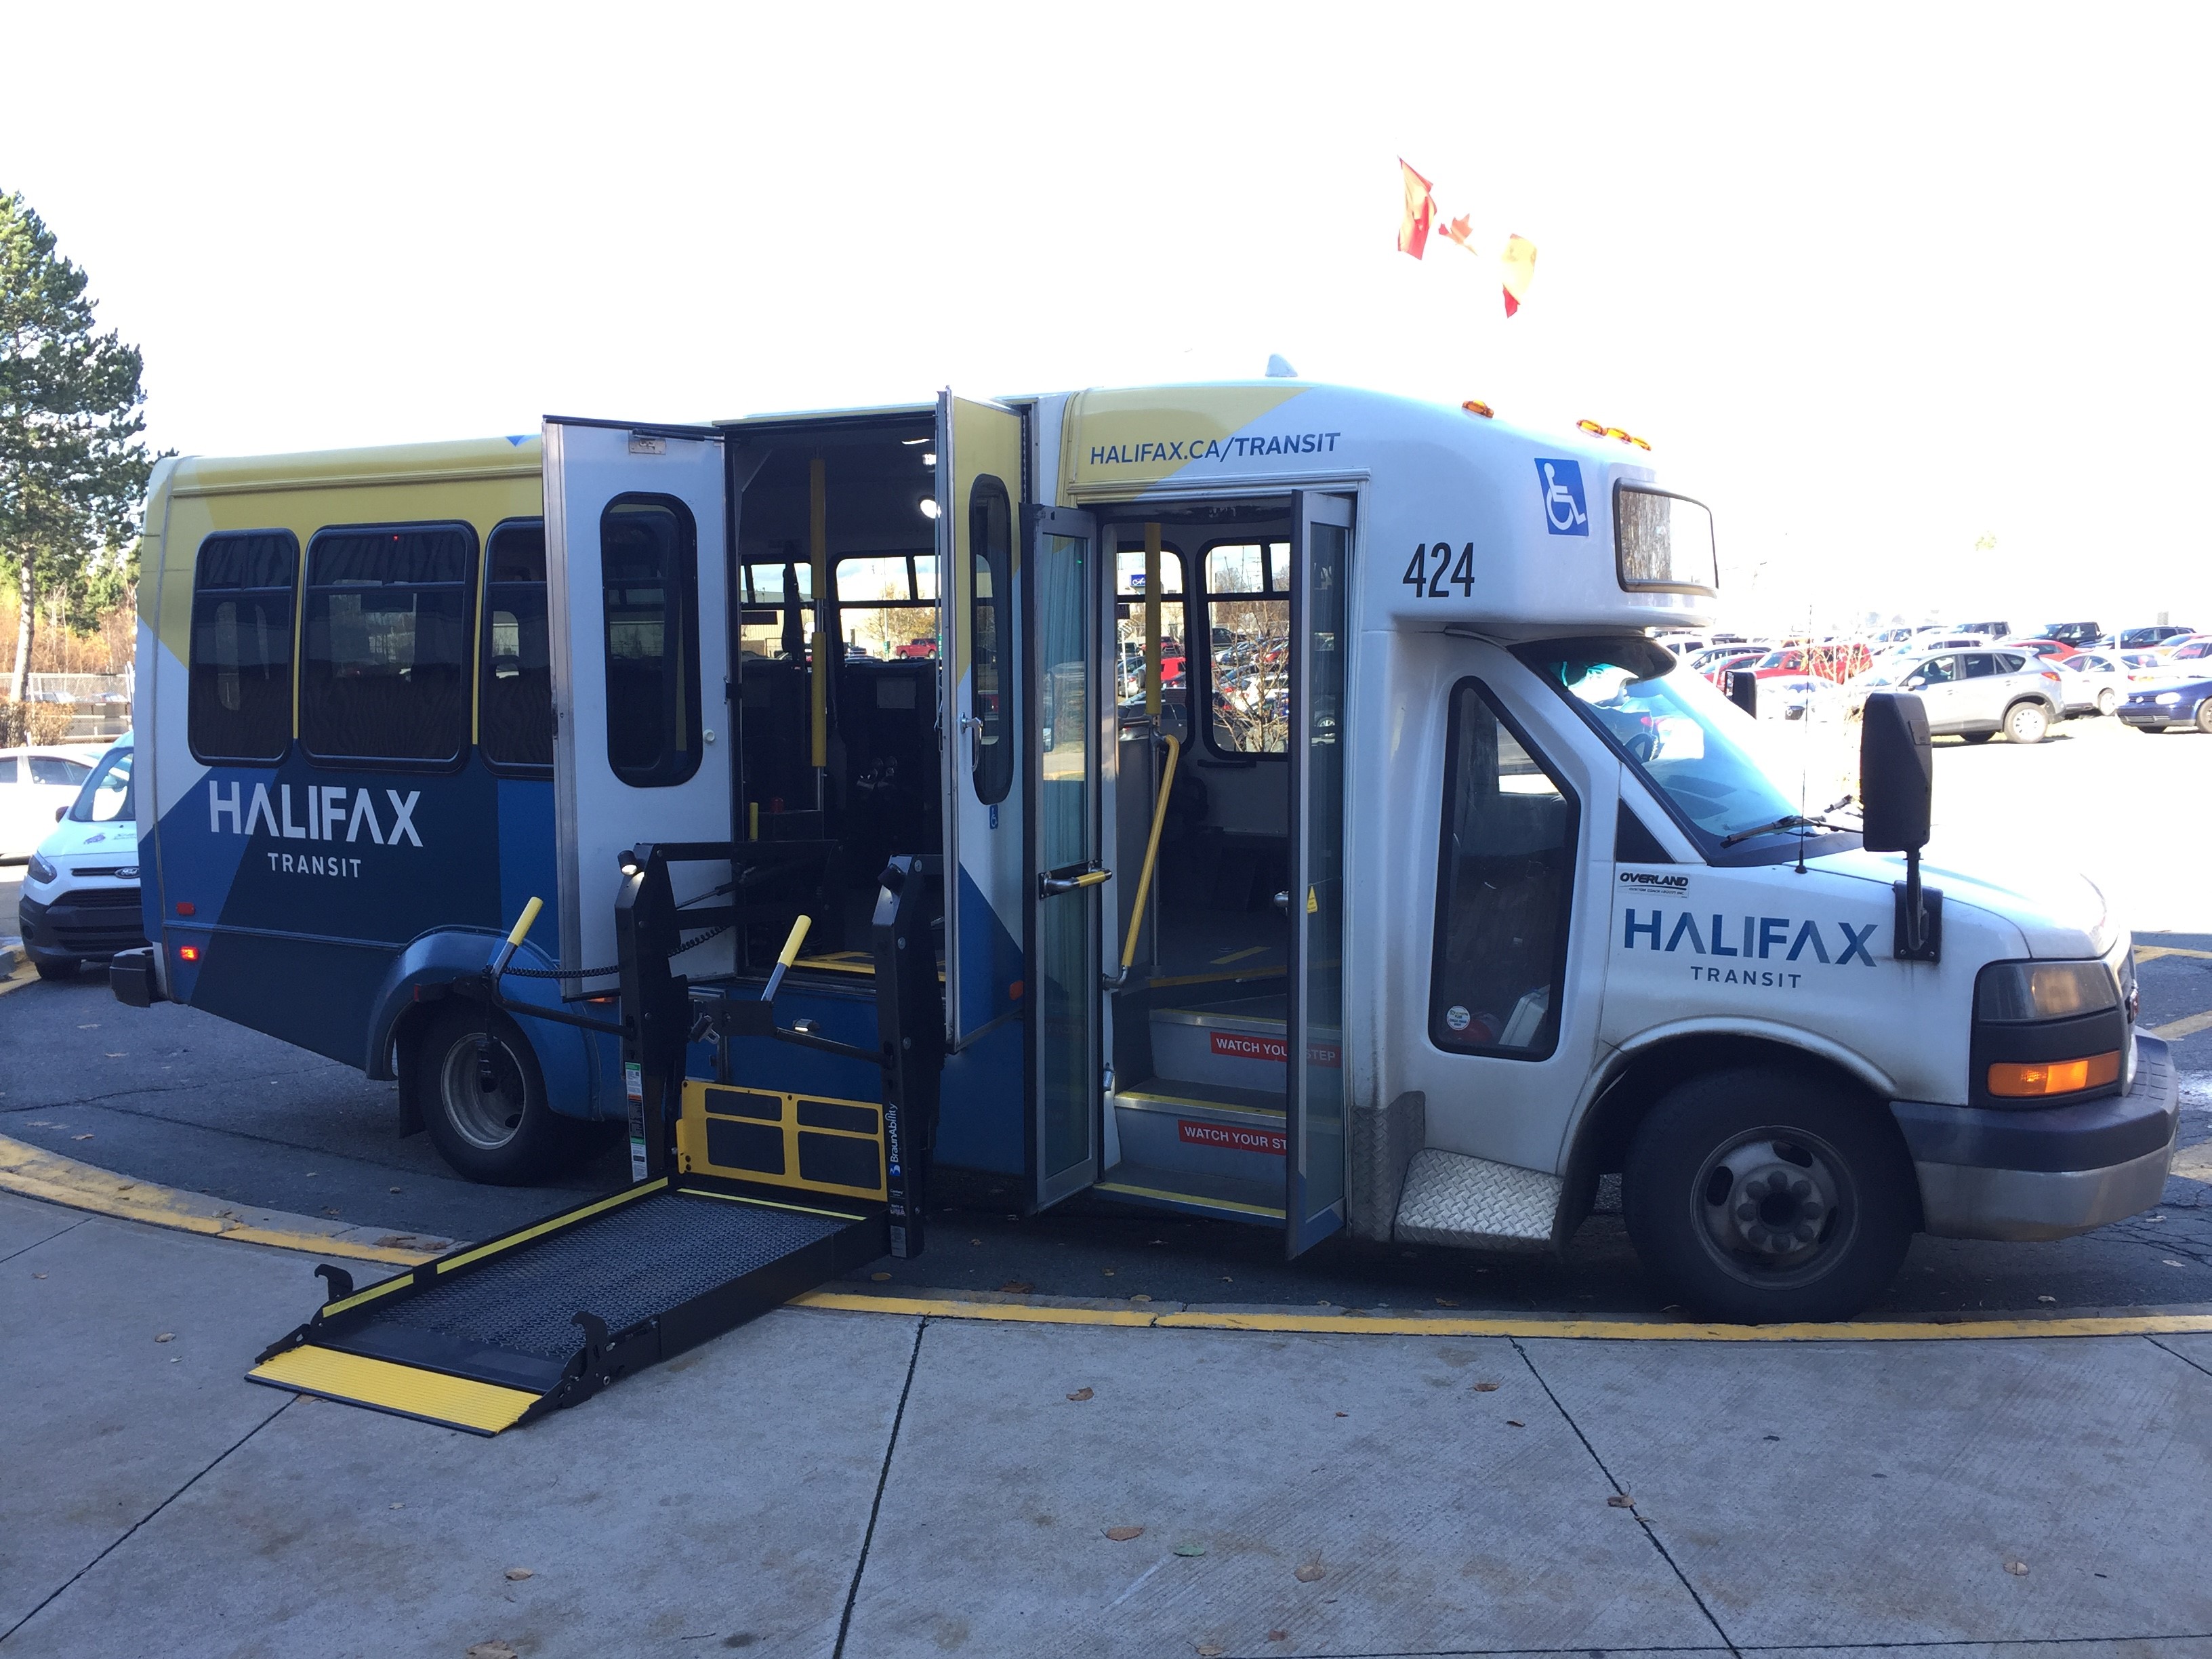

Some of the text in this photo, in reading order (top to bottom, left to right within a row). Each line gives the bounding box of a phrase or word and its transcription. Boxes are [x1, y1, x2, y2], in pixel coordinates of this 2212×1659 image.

[1090, 432, 1341, 466] HALIFAX.CA/TRANSIT
[1402, 541, 1475, 598] 424
[209, 780, 424, 848] HALIFAX
[267, 852, 362, 878] TRANSIT
[1620, 872, 1689, 886] OVERLAND
[1624, 907, 1879, 968] HALIFAX
[1689, 965, 1801, 989] TRANSIT
[1216, 1038, 1260, 1053] WATCH
[1263, 1044, 1288, 1057] YOU
[884, 1101, 899, 1163] BraunAbility
[1184, 1126, 1287, 1150] WATCH YOUR ST
